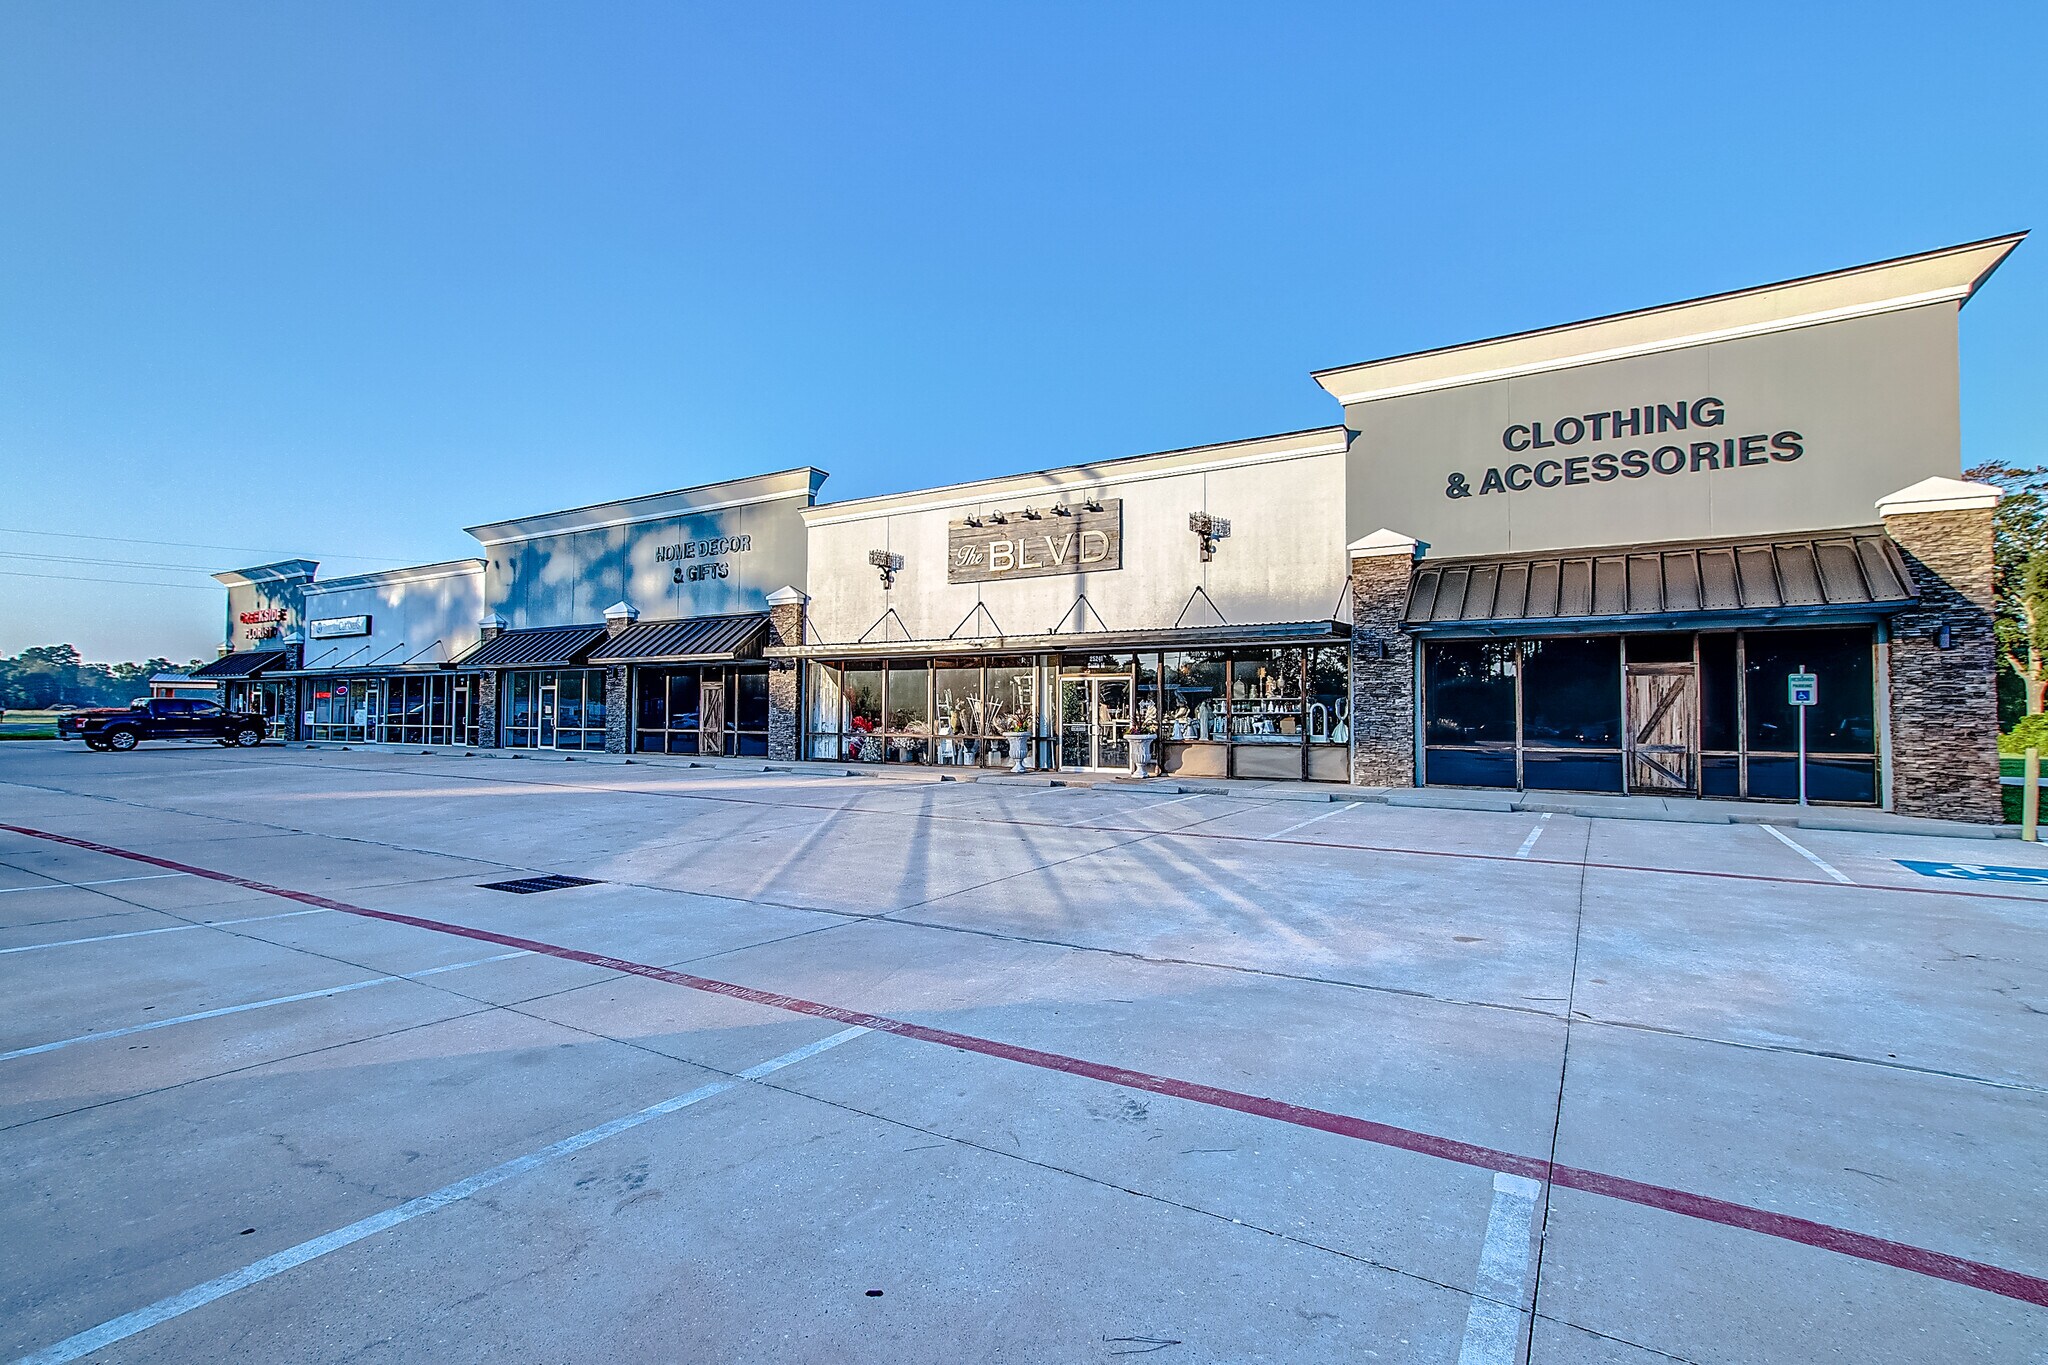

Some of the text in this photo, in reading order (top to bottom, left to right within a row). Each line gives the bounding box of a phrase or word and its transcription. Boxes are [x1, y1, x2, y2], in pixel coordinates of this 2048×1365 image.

[1502, 396, 1725, 452] CLOTHING
[1445, 430, 1804, 499] & ACCESSORIES
[655, 535, 752, 562] HOME DECOR
[955, 530, 1111, 573] The BLVD
[673, 562, 729, 584] & GIFTS
[239, 609, 286, 624] CREEKSIDE
[246, 627, 276, 639] FLORIST
[854, 1016, 902, 1031] FIRE
